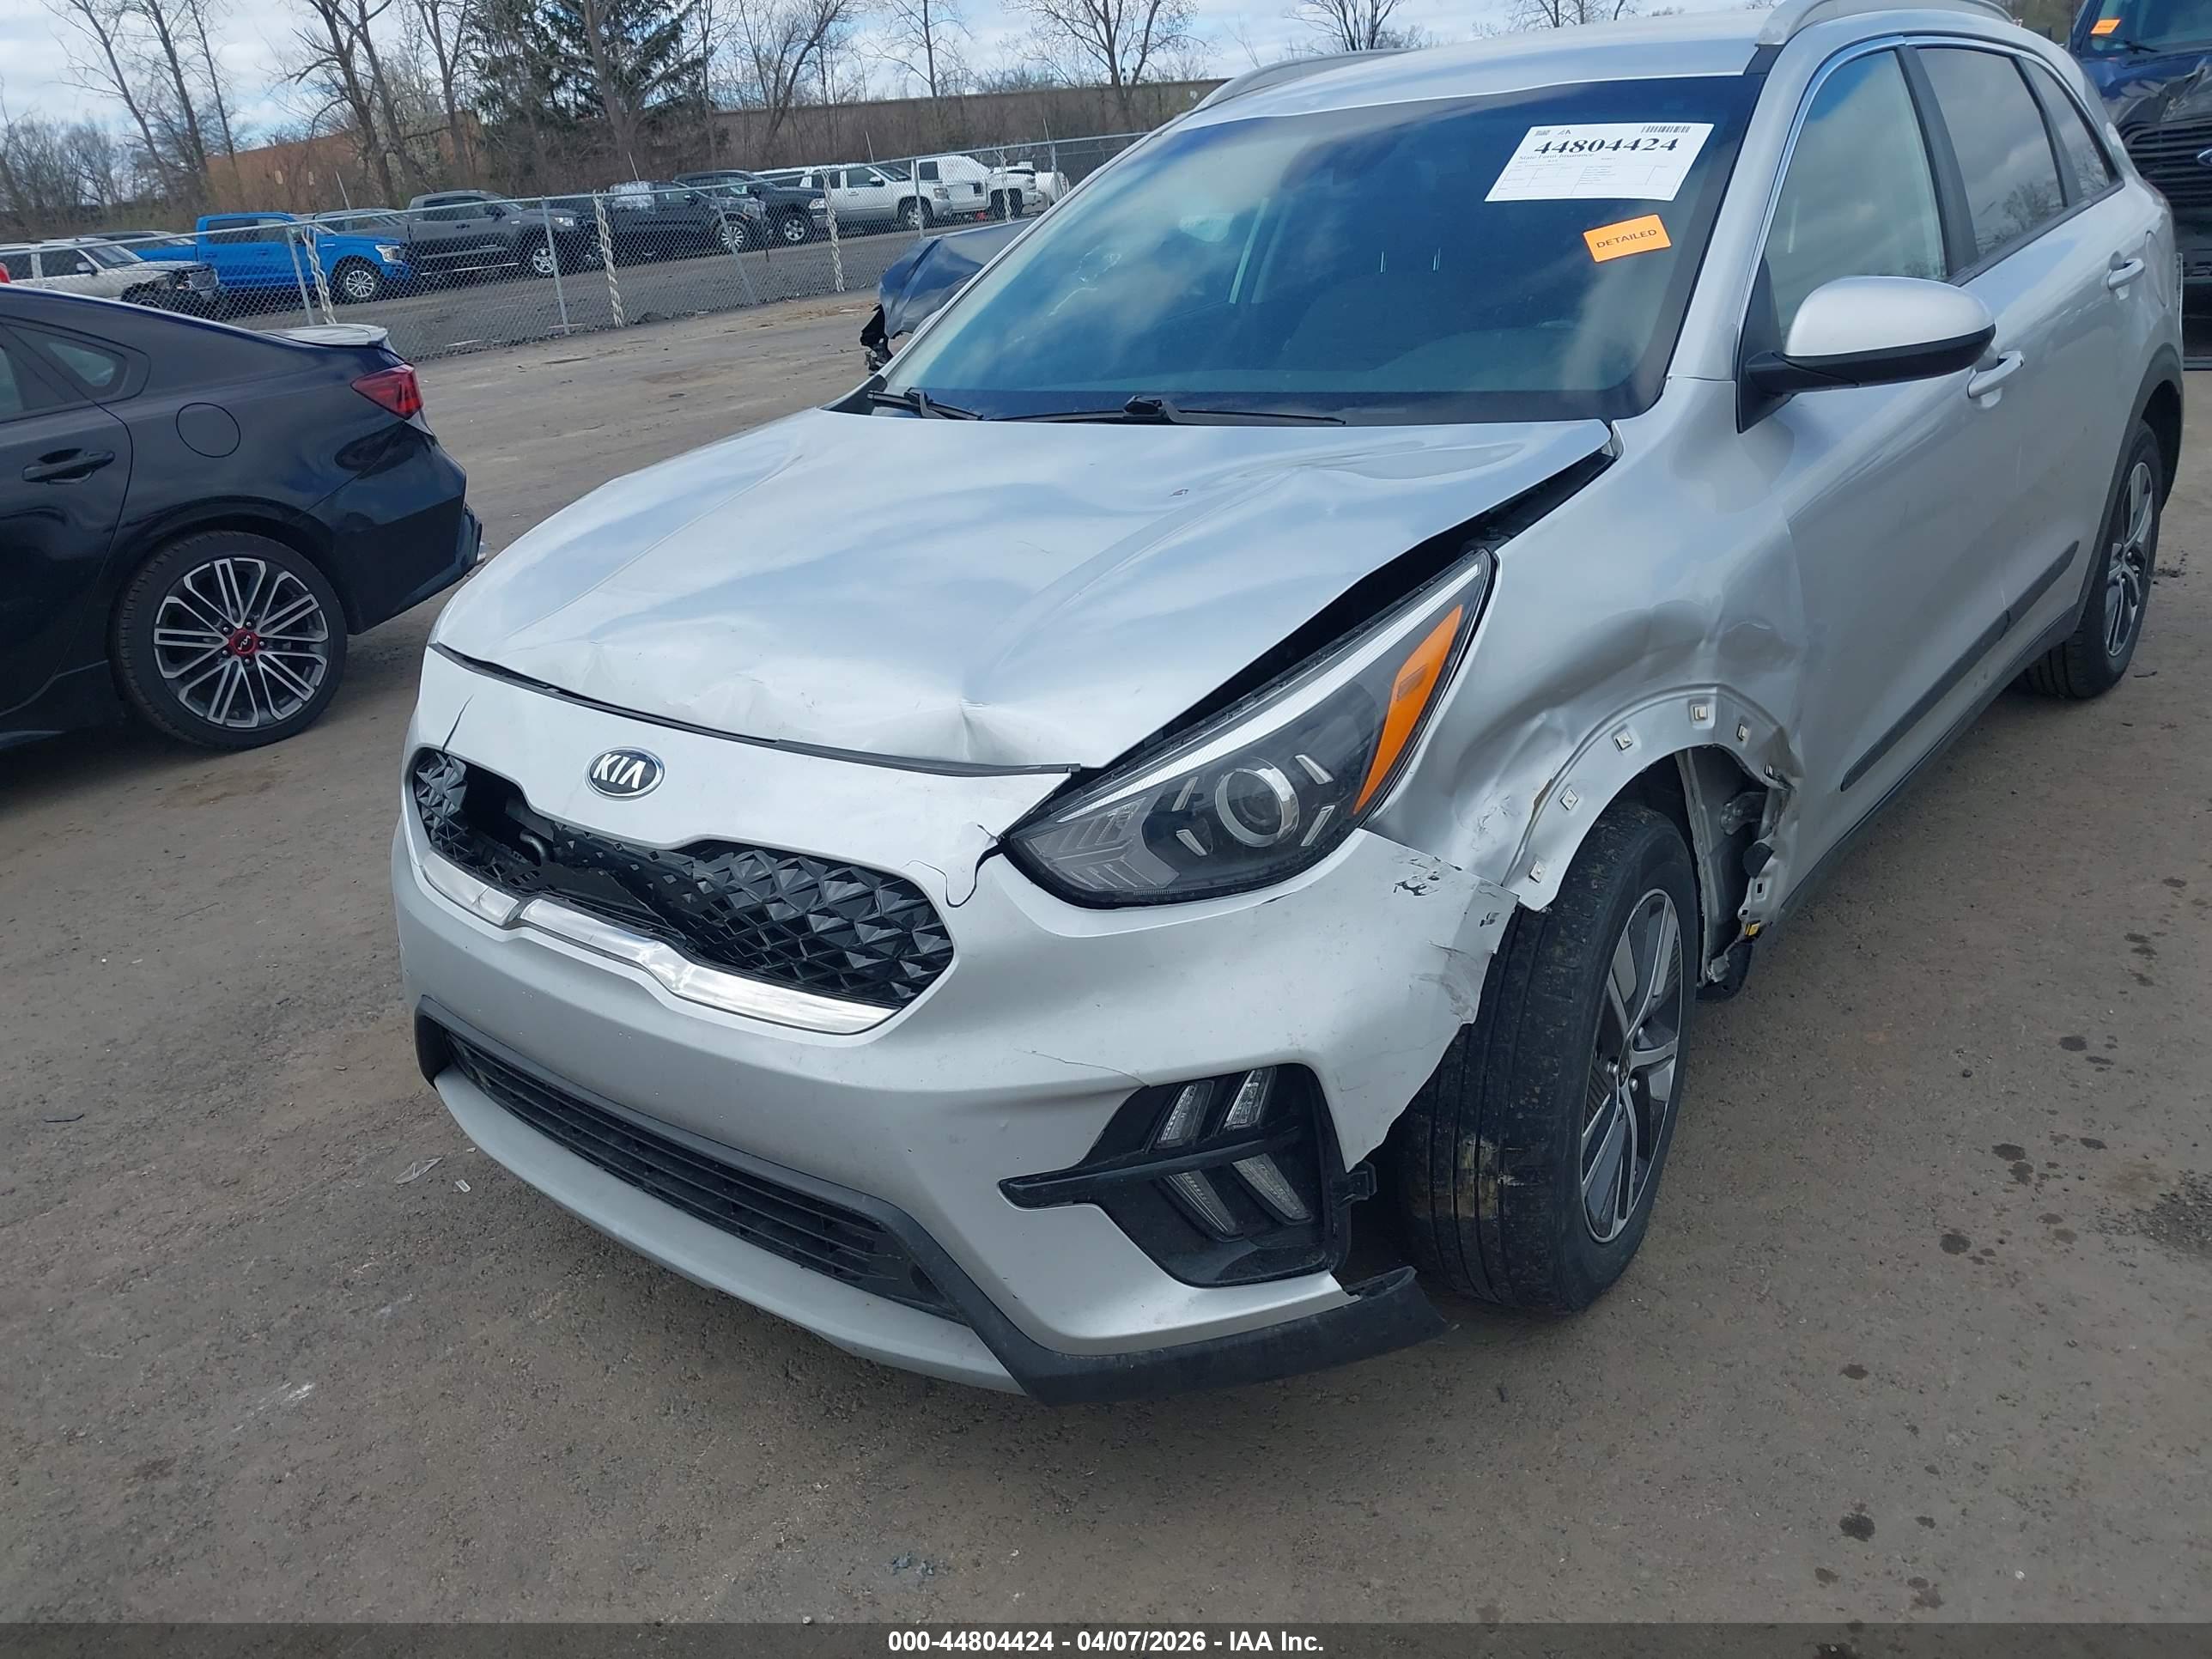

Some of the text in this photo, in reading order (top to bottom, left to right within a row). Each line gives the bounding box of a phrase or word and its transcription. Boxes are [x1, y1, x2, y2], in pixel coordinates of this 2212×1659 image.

[1534, 137, 1679, 155] 44804424
[1596, 229, 1657, 248] DETAILED
[592, 753, 647, 789] KIA
